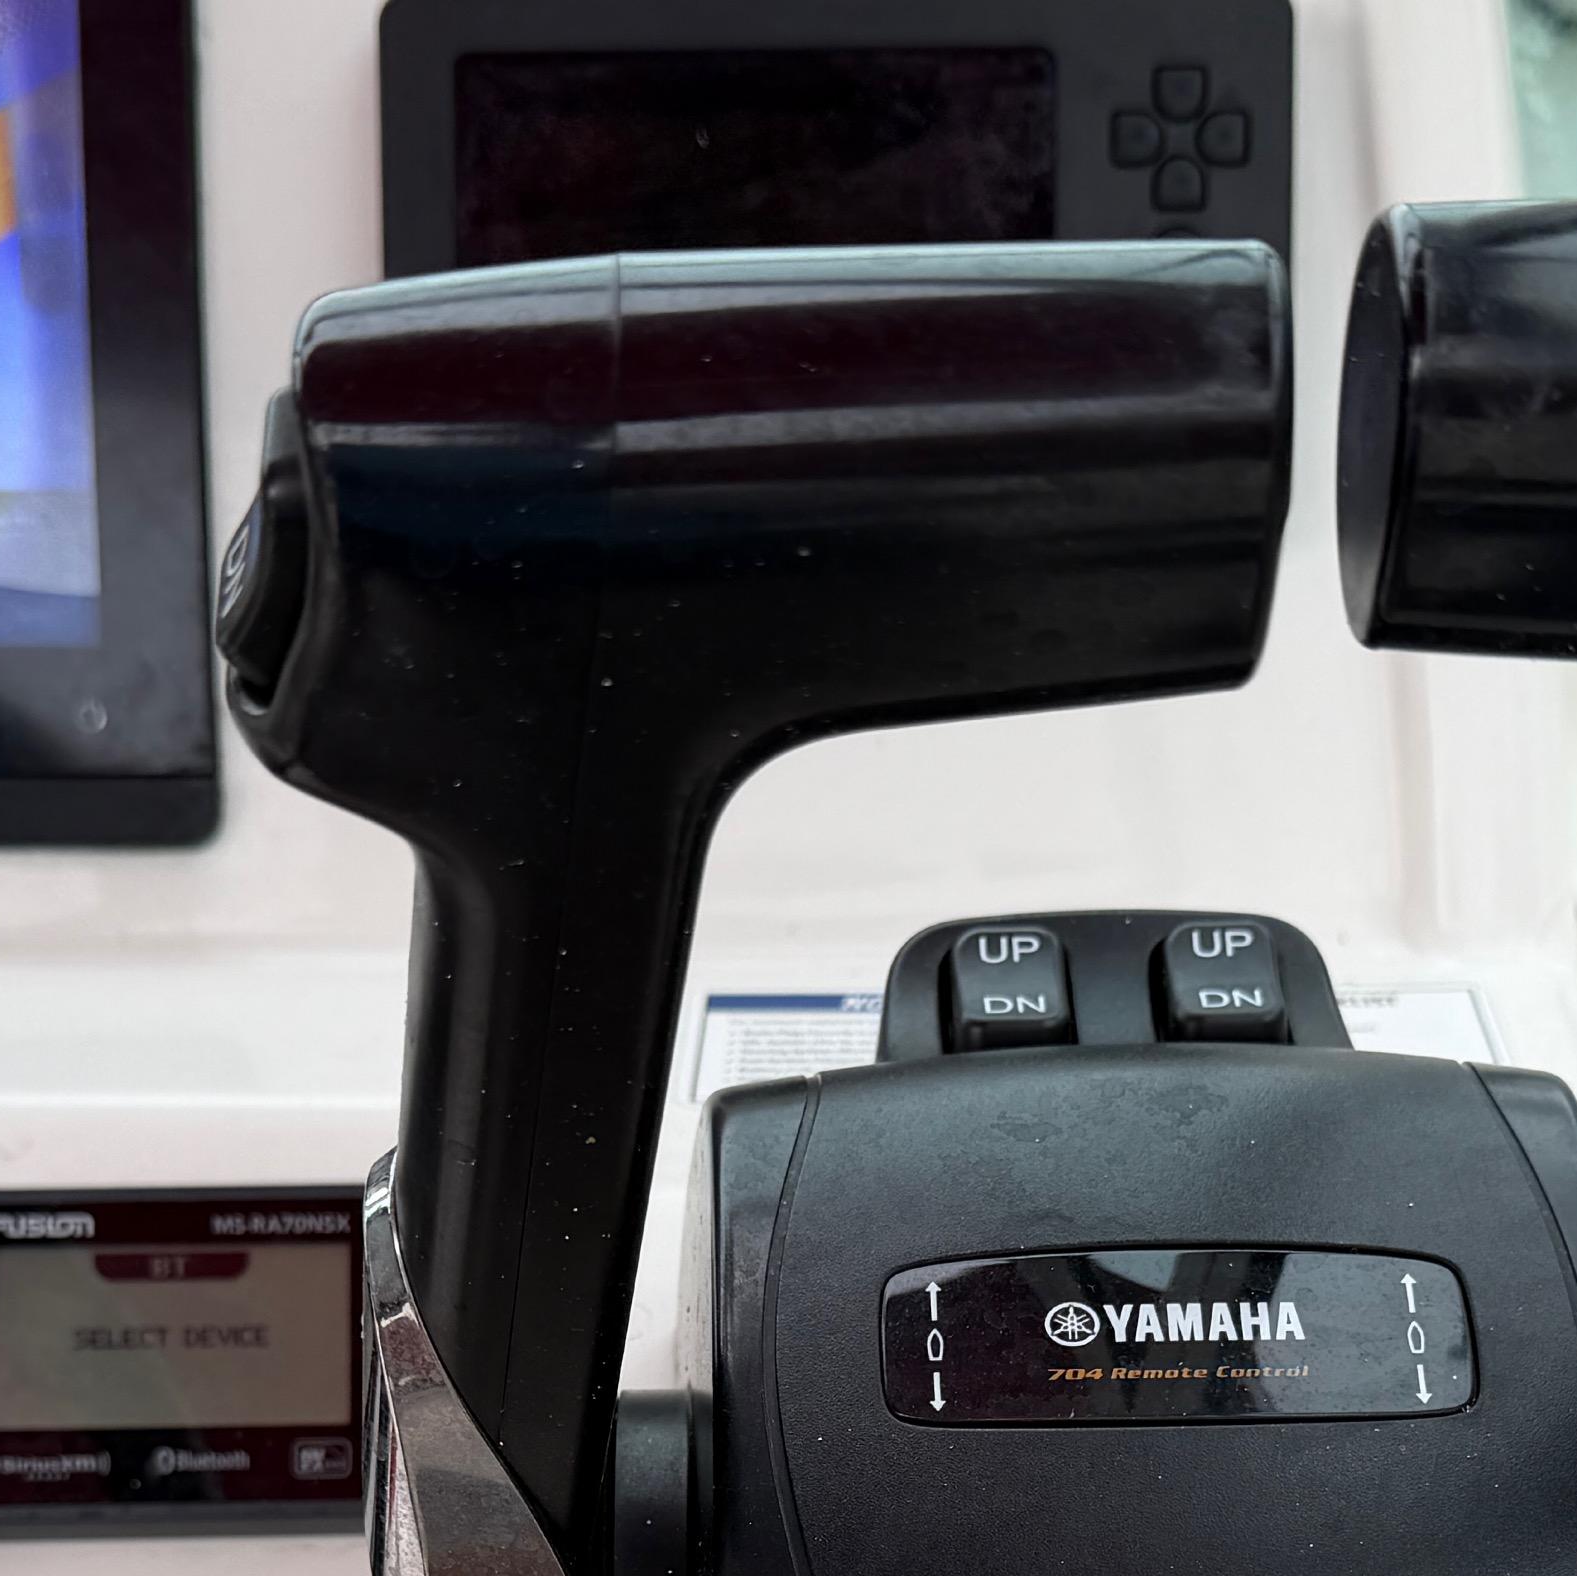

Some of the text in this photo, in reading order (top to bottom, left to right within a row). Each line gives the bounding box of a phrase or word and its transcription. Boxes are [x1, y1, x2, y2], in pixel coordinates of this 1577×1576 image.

[978, 936, 1040, 963] UP
[1192, 930, 1254, 958] UP
[983, 995, 1046, 1014] DN
[1198, 988, 1263, 1008] DN
[149, 1256, 189, 1279] BT
[1103, 1301, 1306, 1342] YAMAHA
[73, 1324, 271, 1350] SELECT DEVICE
[1047, 1364, 1310, 1381] 704 Remote Control
[176, 1449, 250, 1472] Bluetooth
